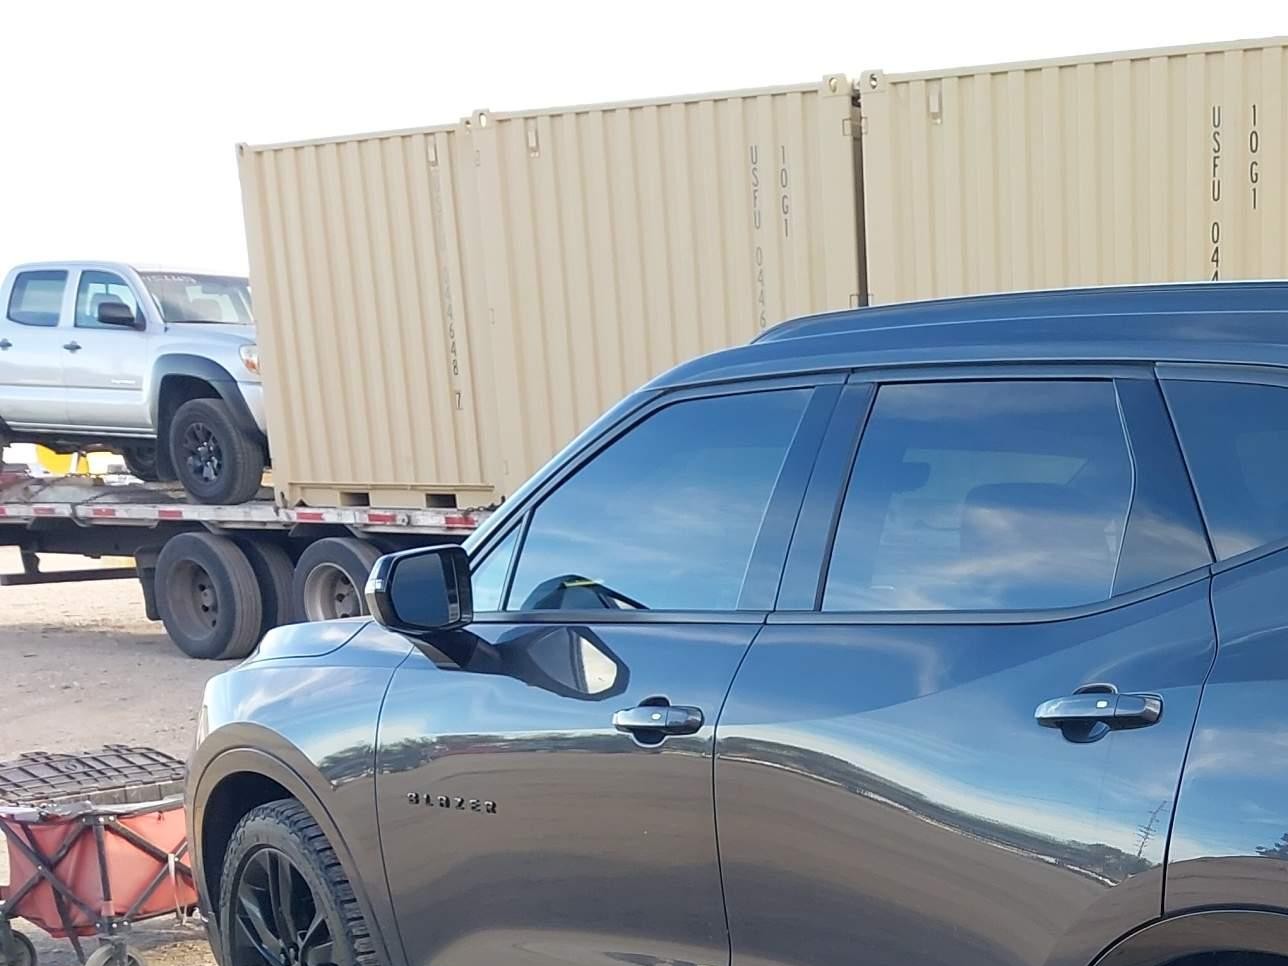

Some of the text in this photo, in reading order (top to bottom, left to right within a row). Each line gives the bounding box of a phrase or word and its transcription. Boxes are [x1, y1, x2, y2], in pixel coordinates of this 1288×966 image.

[750, 144, 761, 230] USFU
[1212, 105, 1221, 202] USFU
[407, 792, 497, 814] BLAZER
